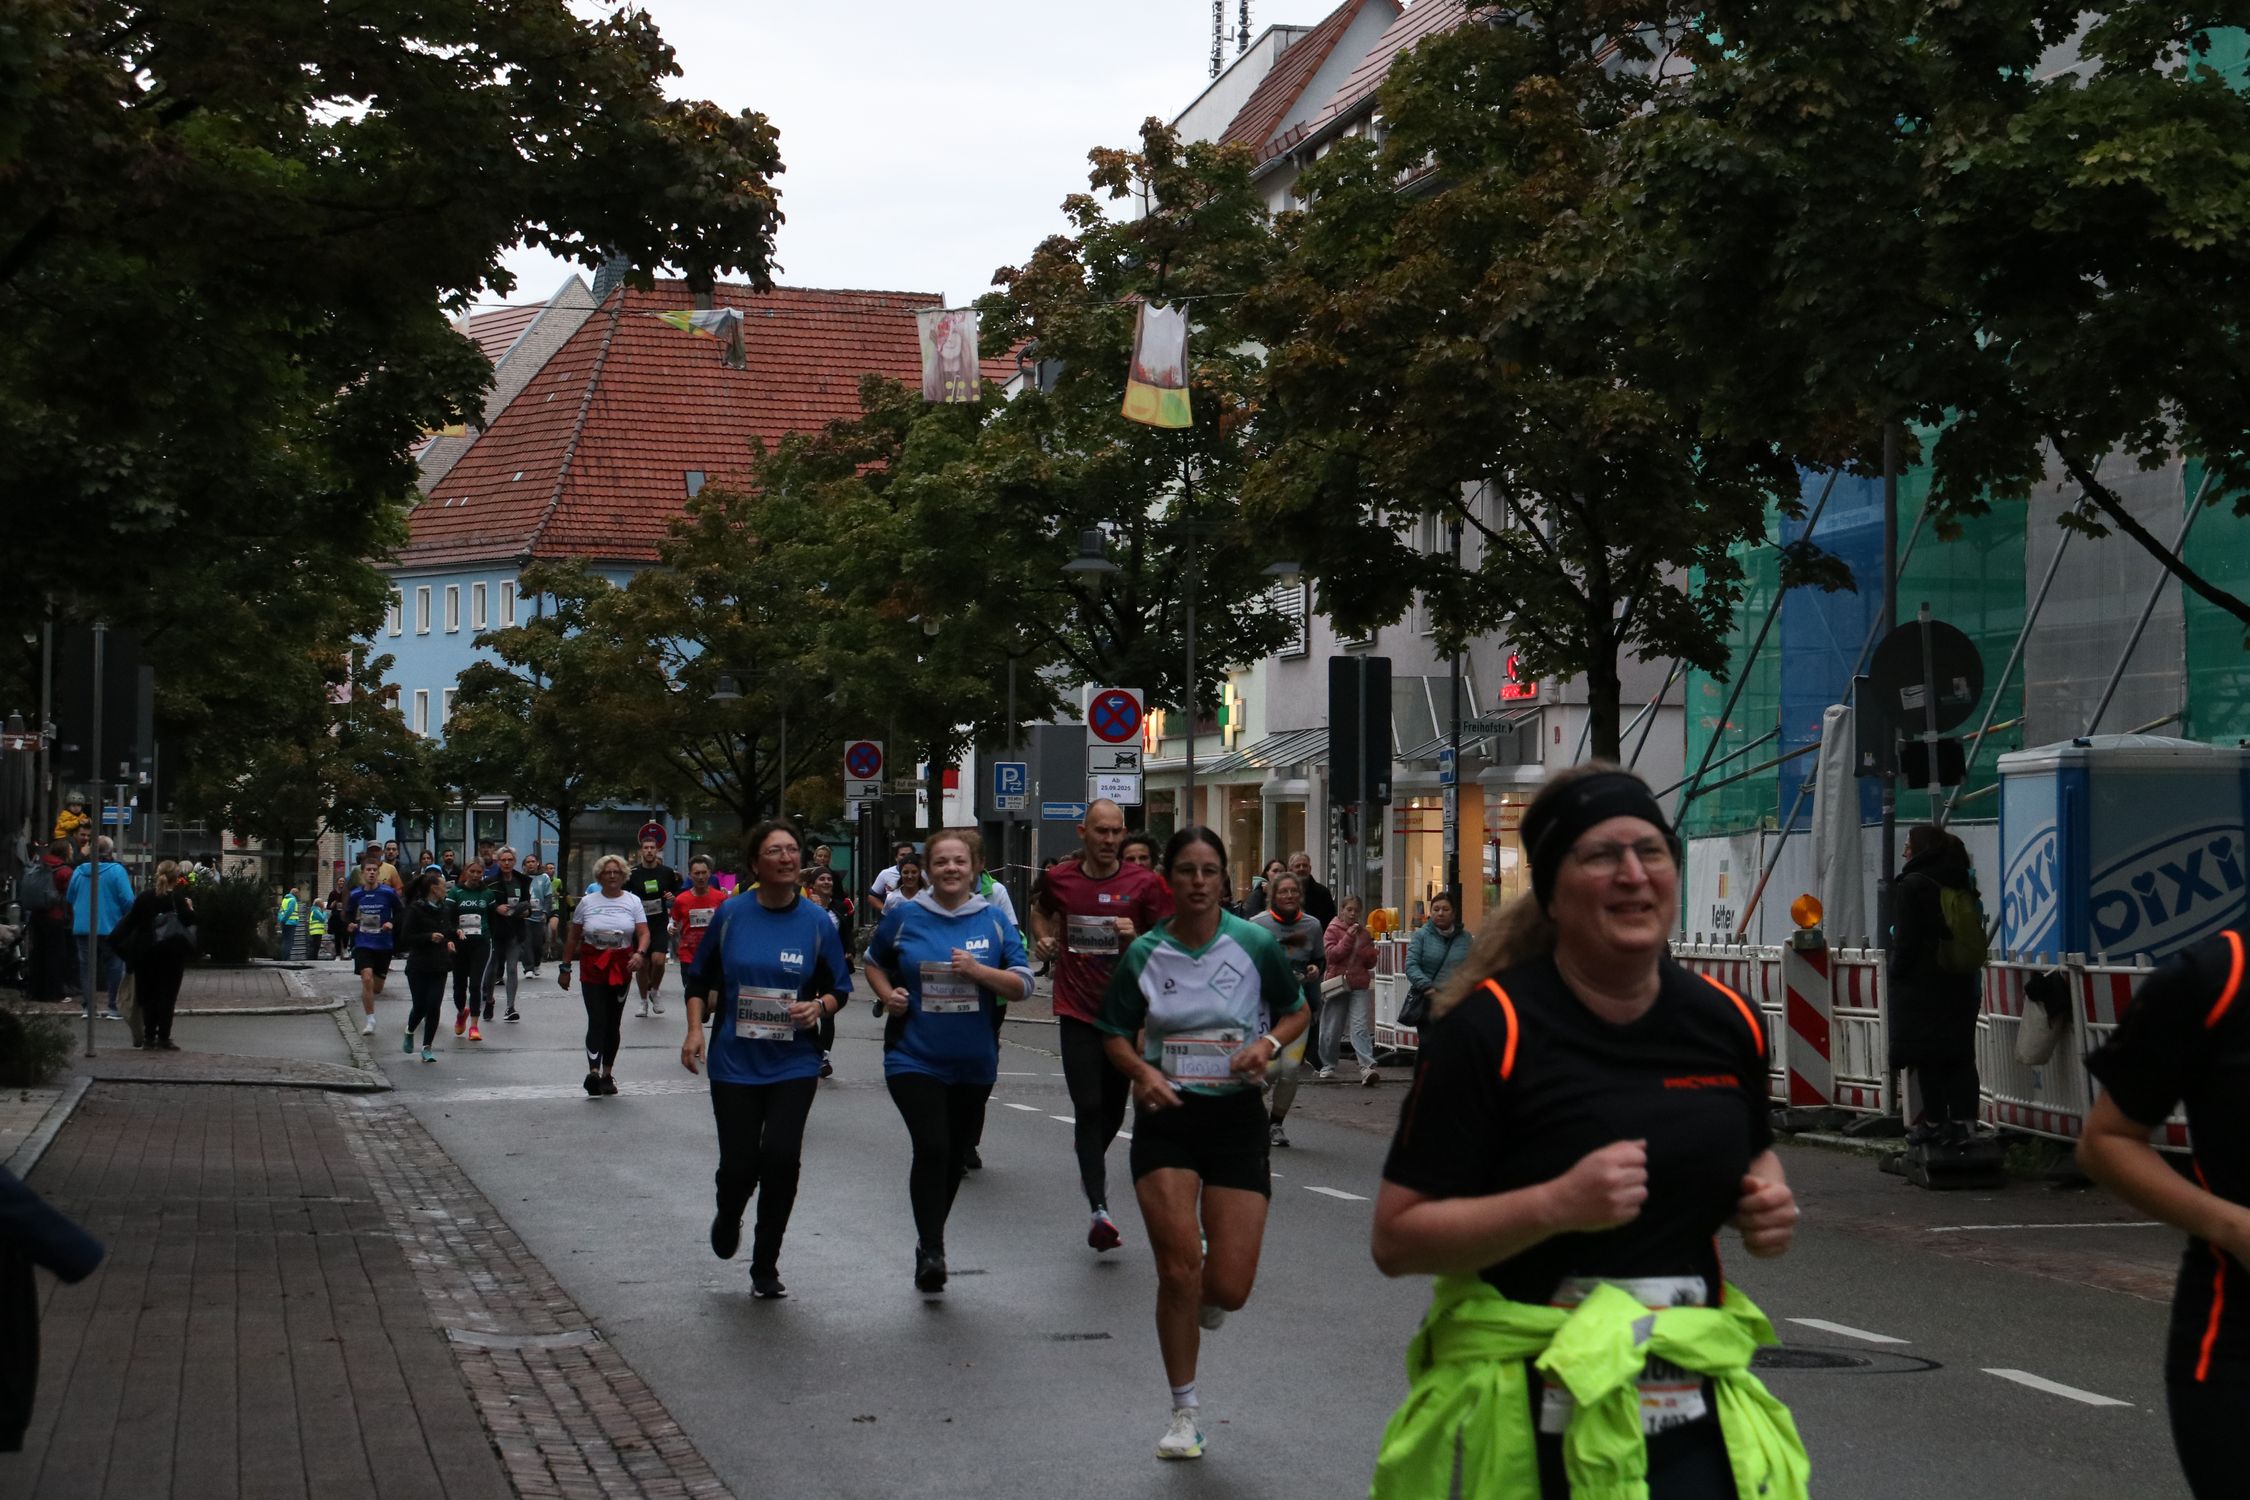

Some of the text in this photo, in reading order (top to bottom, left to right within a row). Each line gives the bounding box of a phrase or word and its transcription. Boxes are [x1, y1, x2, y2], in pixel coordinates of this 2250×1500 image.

[1463, 721, 1508, 734] Freihofstr.
[1002, 767, 1019, 791] P
[965, 939, 989, 950] DAA
[1069, 935, 1115, 947] Reinhold
[780, 952, 804, 965] DAA
[739, 1008, 791, 1023] Elisabeth
[1165, 1045, 1188, 1055] 1513
